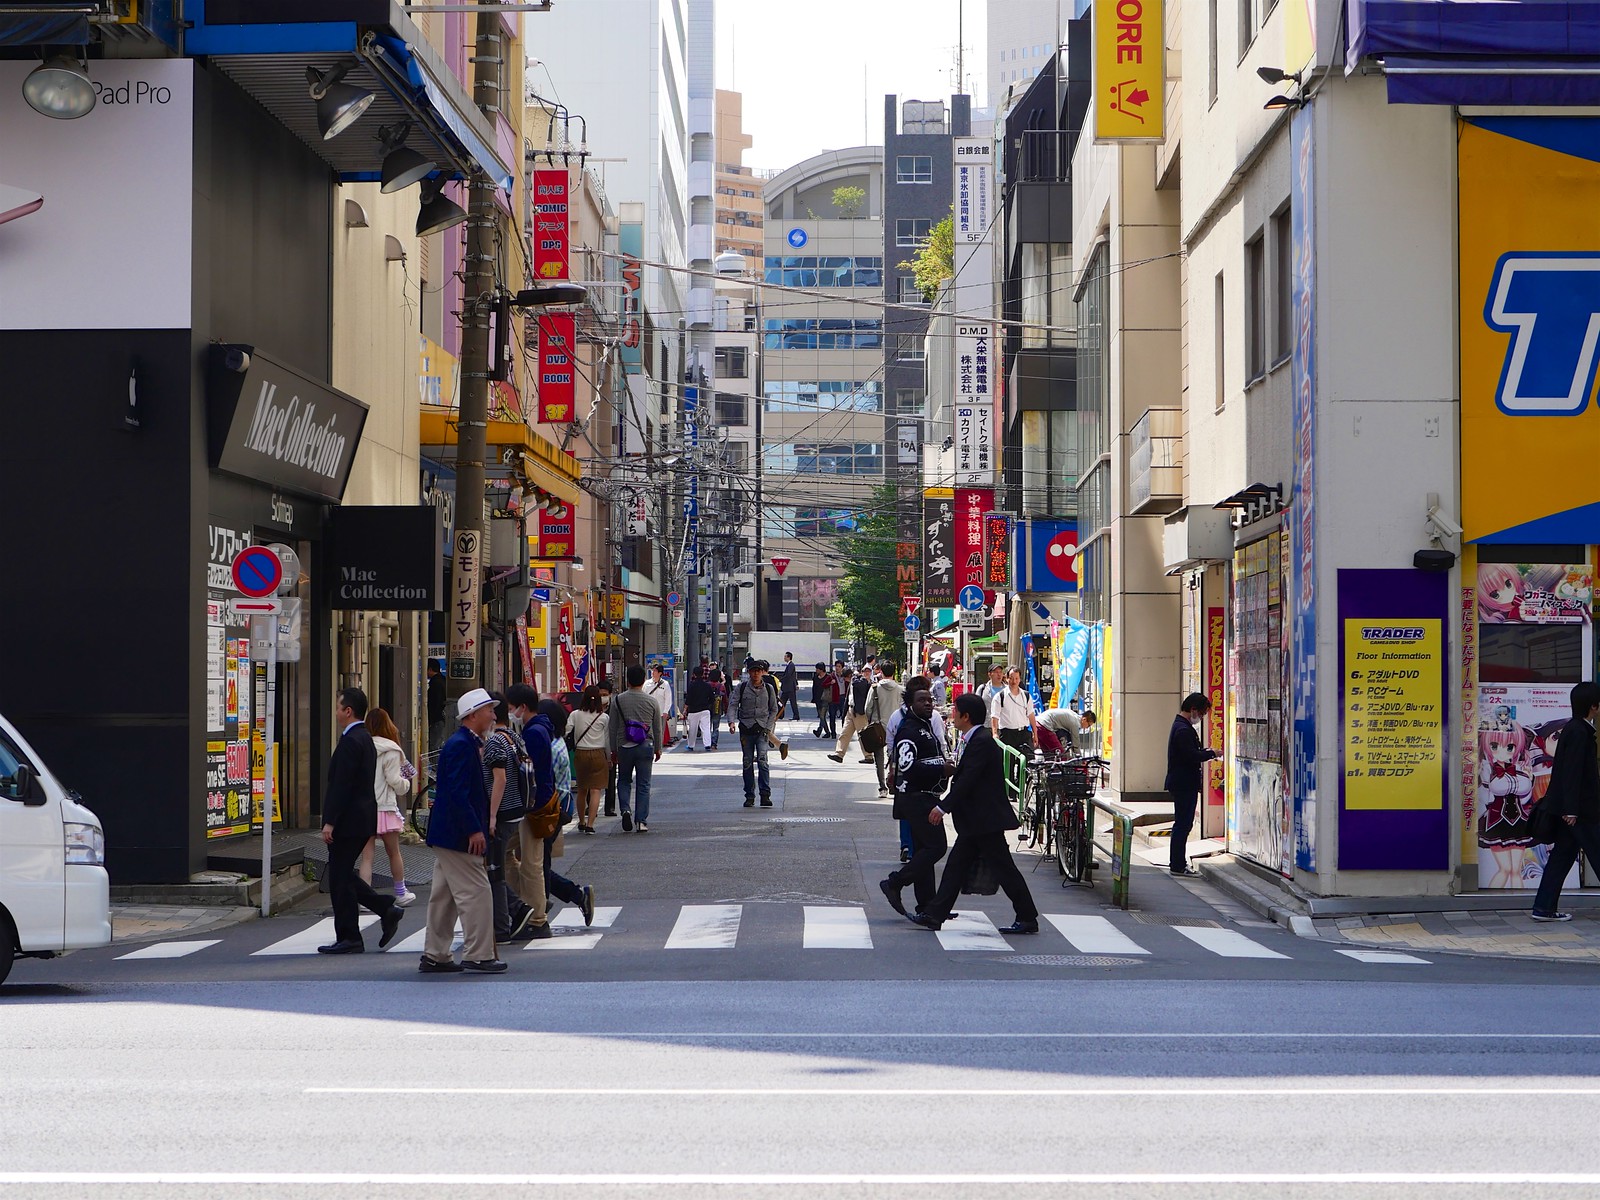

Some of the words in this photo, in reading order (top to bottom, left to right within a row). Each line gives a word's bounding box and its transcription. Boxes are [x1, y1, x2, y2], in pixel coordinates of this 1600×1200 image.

[1116, 0, 1142, 64] ORE
[136, 81, 172, 104] Pro
[957, 146, 990, 155] 白銀会館
[537, 185, 564, 196] 同人誌
[960, 166, 970, 232] 東京氷卸協同組合
[538, 222, 565, 233] アニメ
[967, 233, 981, 242] 5F
[539, 261, 564, 278] 4F
[959, 327, 988, 336] D.M.D
[546, 354, 568, 366] DVD
[543, 373, 571, 384] BOOK
[961, 355, 973, 394] 株式会社
[545, 403, 568, 420] 3F
[968, 474, 982, 482] 2F
[271, 493, 294, 532] Sofmap
[967, 492, 982, 546] 中華料理
[543, 525, 571, 534] BOOK
[208, 524, 251, 564] ソフマップ
[545, 542, 568, 557] 2F
[341, 566, 377, 582] Mac
[340, 584, 428, 600] Collection
[456, 555, 474, 638] モリヤマ
[1361, 627, 1425, 640] TRADER
[1356, 653, 1378, 661] Floor
[1382, 653, 1432, 661] Information
[1367, 670, 1420, 679] アダルトDVD
[1366, 686, 1405, 696] PCゲーム
[1351, 736, 1364, 744] 2F
[1367, 736, 1433, 744] レトロゲーム・海外ゲーム
[1353, 752, 1364, 761] 1F
[1367, 752, 1436, 761] TVゲーム・スマートフォン
[1347, 769, 1364, 777] B1F
[1368, 768, 1415, 777] 買取フロア
